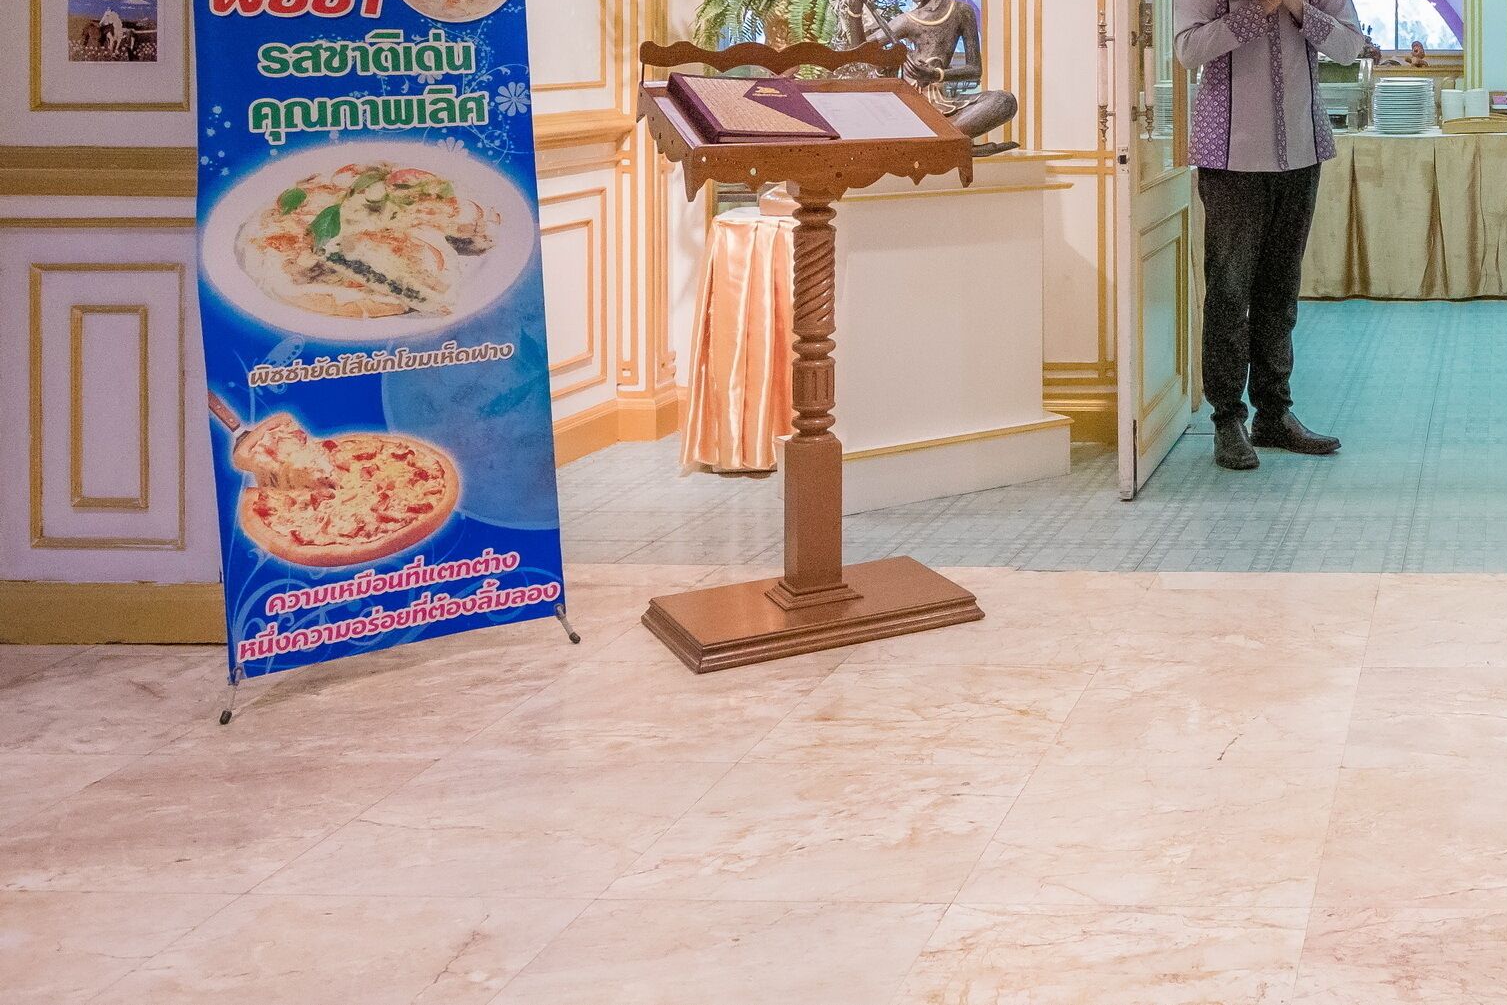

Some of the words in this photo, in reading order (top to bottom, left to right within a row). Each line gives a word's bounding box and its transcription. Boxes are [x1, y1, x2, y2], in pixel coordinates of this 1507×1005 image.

[258, 30, 476, 76] รสชาติเด่น
[249, 86, 489, 145] คุณภาพเลิศ
[266, 548, 520, 615] ความเหมือนที่แตกต่าง
[237, 580, 562, 662] หนึ่งความอร่อยที่ต้องลิ้มลอง
